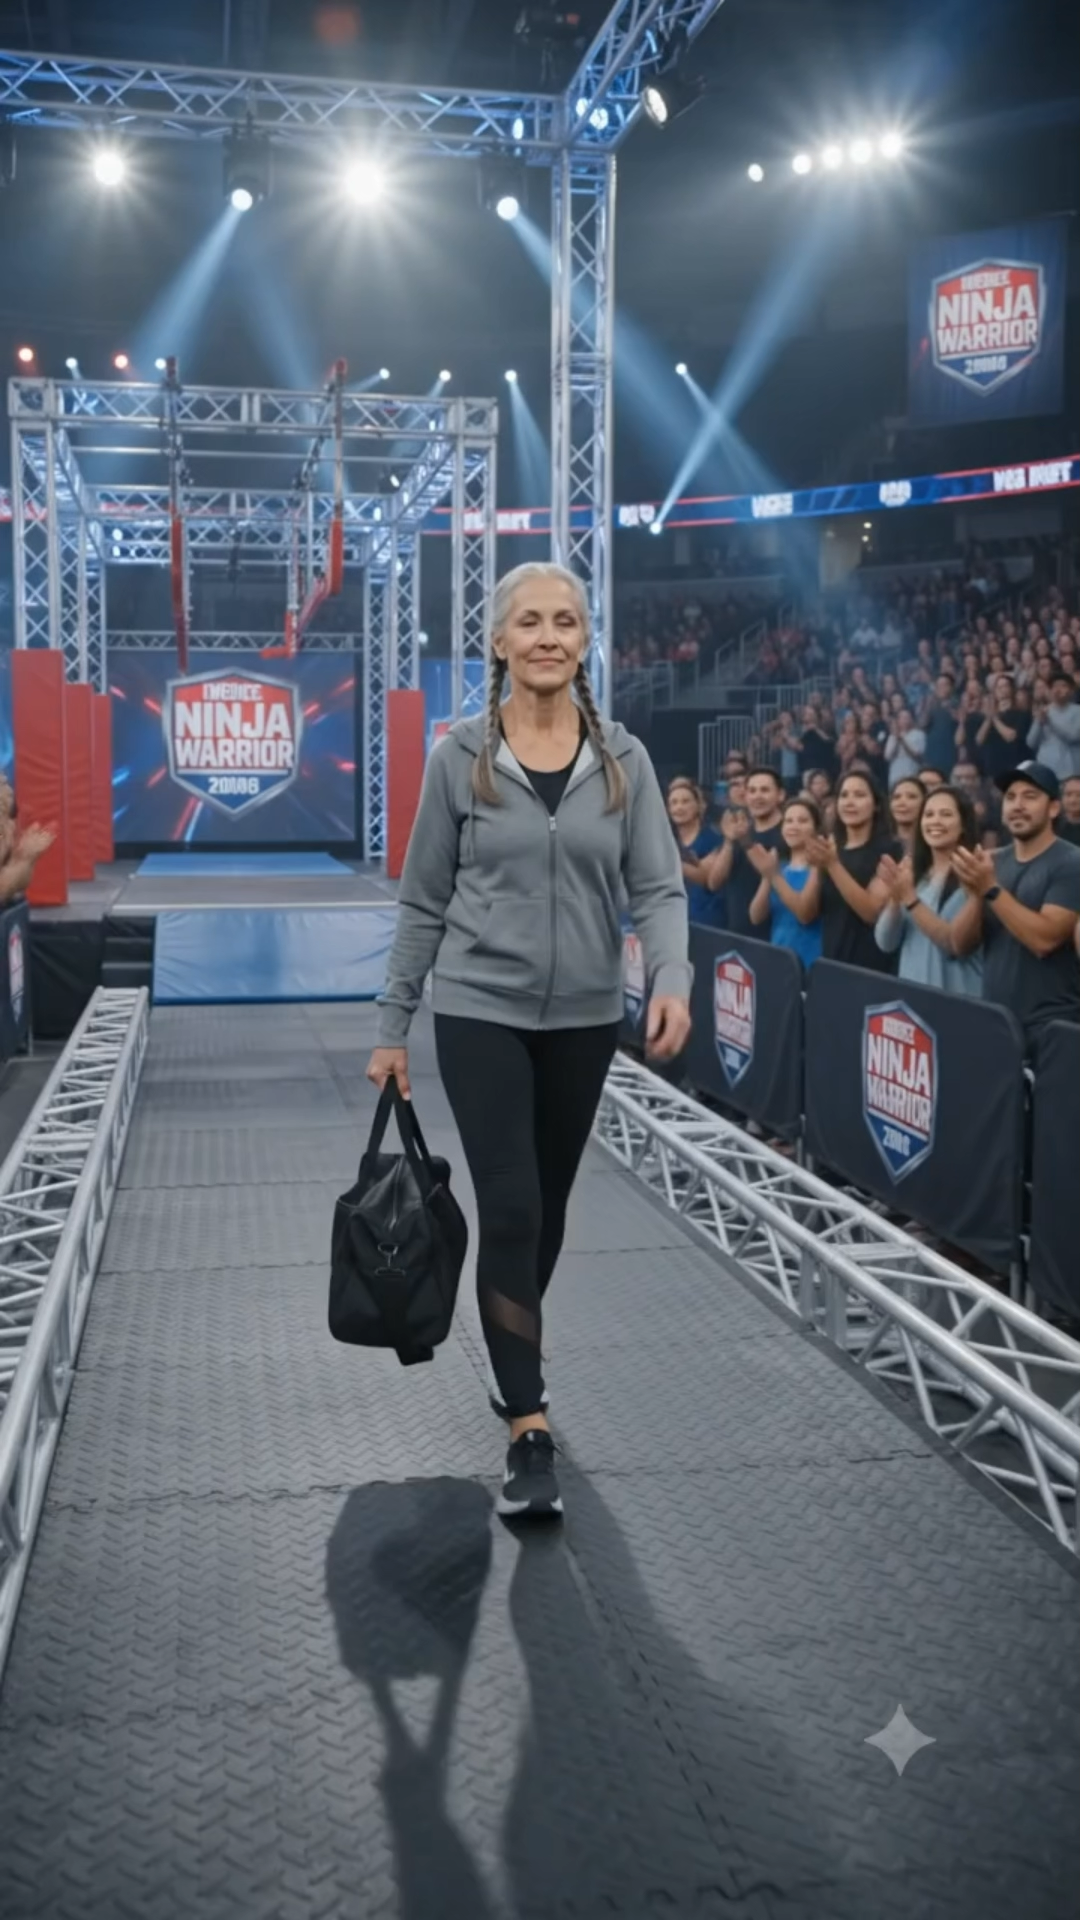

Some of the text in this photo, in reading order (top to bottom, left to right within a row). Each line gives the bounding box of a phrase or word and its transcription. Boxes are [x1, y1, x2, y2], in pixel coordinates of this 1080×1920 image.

[938, 285, 1036, 327] NINJA
[937, 318, 1038, 353] WARRIOR
[174, 701, 292, 738] NINJA
[174, 738, 294, 768] WARRIOR
[867, 1032, 931, 1098] NINJA
